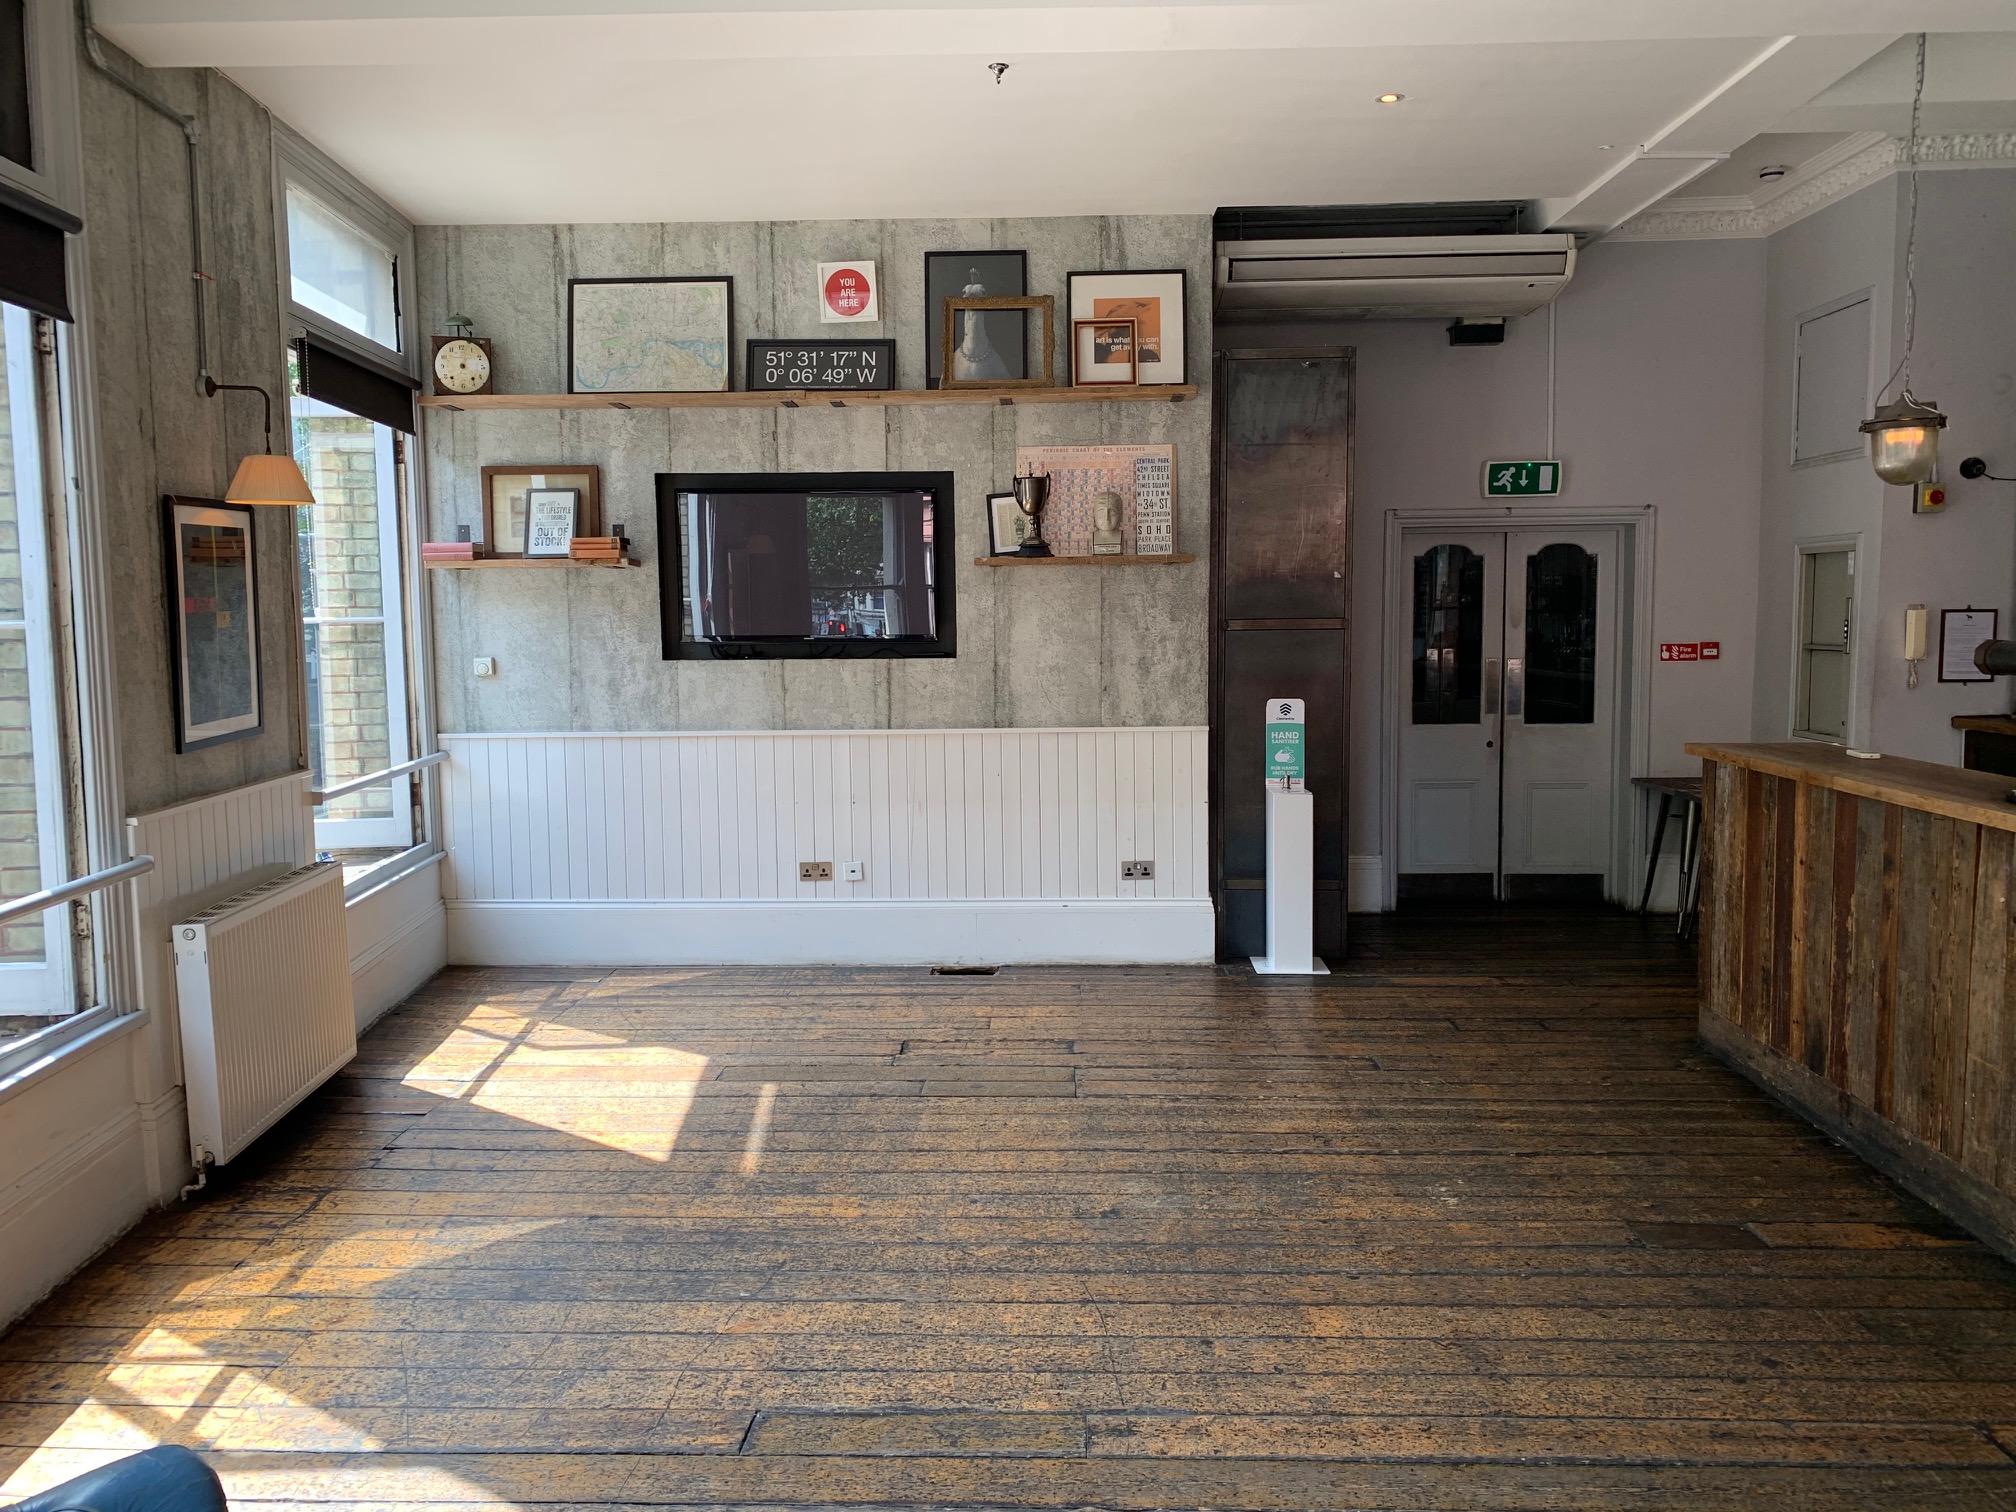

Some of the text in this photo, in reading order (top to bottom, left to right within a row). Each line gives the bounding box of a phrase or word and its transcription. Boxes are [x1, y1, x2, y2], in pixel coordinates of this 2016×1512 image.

[839, 278, 855, 287] YOU
[840, 288, 856, 297] ARE
[838, 298, 859, 307] HERE
[1106, 336, 1112, 344] is
[1110, 344, 1123, 352] get
[765, 351, 876, 366] 51° 31' 17" N
[765, 368, 876, 383] 0° 06' 49" W
[1159, 498, 1170, 510] ST.
[536, 506, 572, 514] THE LIFESTYLE
[537, 527, 569, 537] OUT OF
[1138, 524, 1171, 535] SOHO
[534, 536, 566, 546] STOCK!
[1138, 544, 1172, 554] BROADWAY
